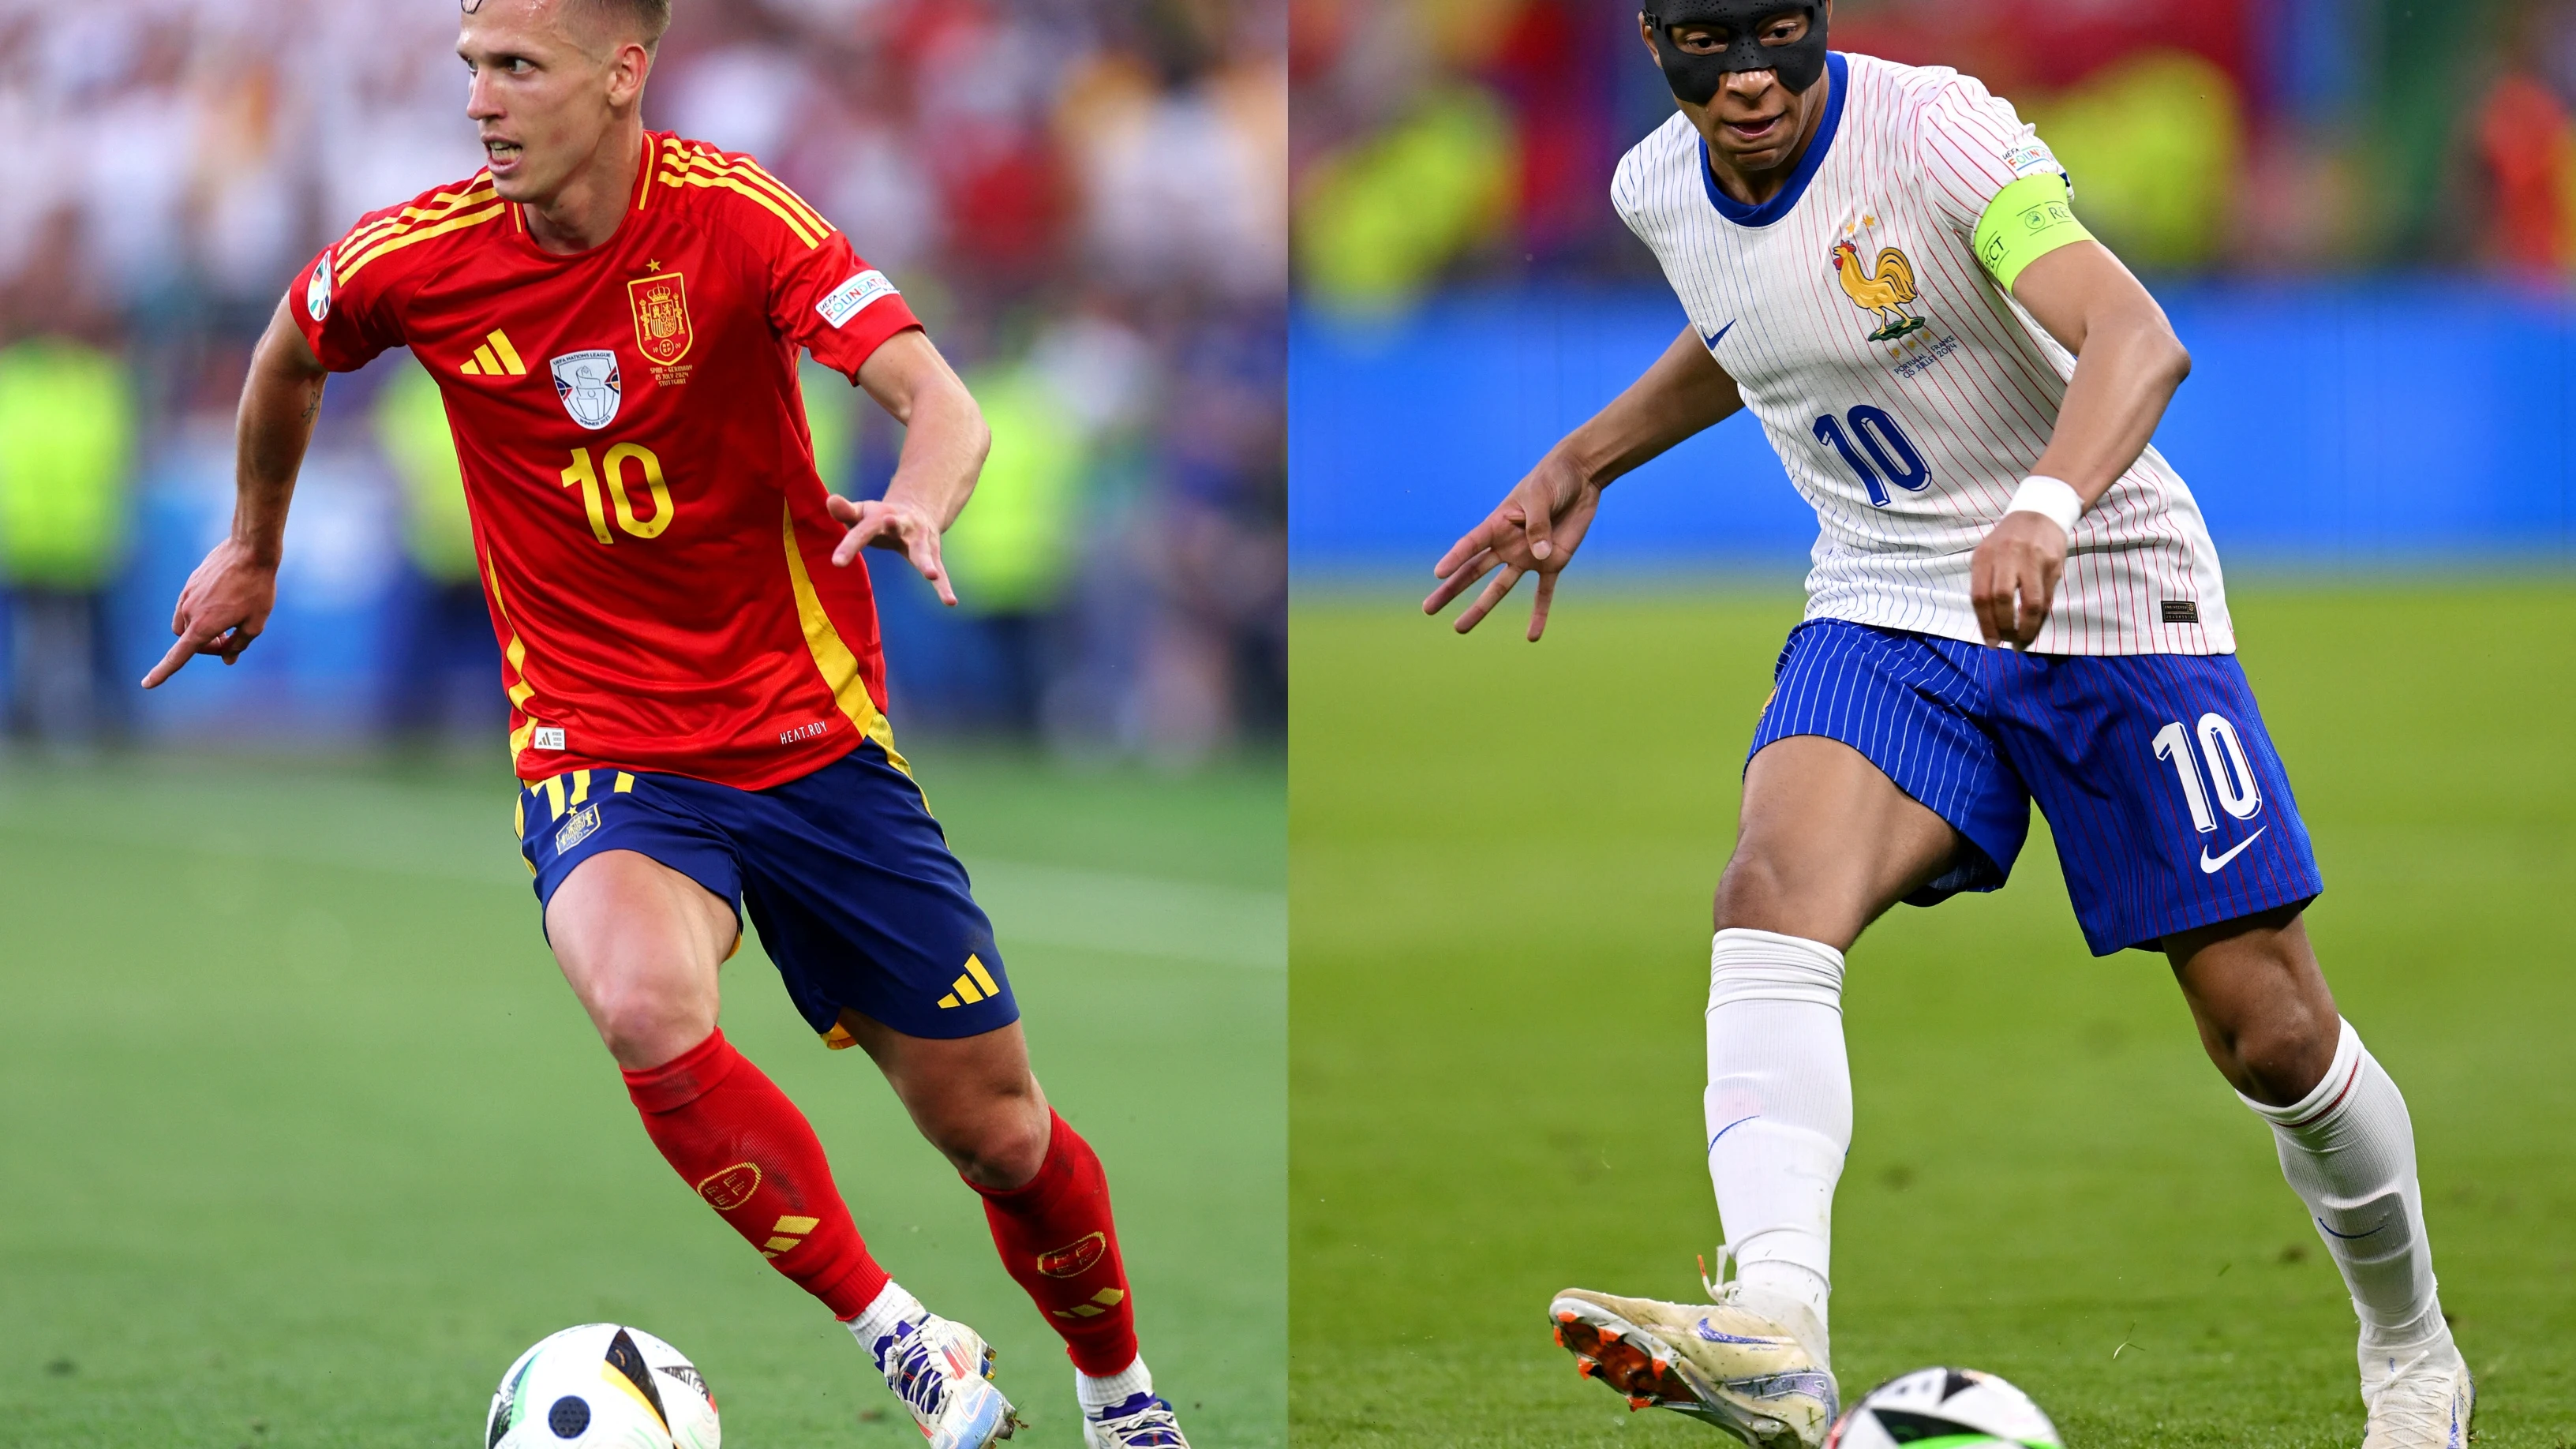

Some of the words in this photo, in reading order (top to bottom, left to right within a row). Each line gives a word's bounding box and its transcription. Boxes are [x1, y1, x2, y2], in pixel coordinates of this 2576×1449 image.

[2002, 148, 2020, 159] UEFA
[1985, 236, 2004, 269] ECT
[820, 295, 838, 311] UEFA
[1894, 353, 1927, 375] PORTUGAL
[1930, 335, 1956, 352] FRANCE
[1903, 368, 1915, 379] 05
[1936, 343, 1957, 358] 2024
[579, 417, 600, 426] WINNER
[1813, 405, 1932, 507] 10
[561, 443, 674, 544] 10
[780, 721, 827, 745] HEAT.RDY
[2151, 712, 2263, 833] 10
